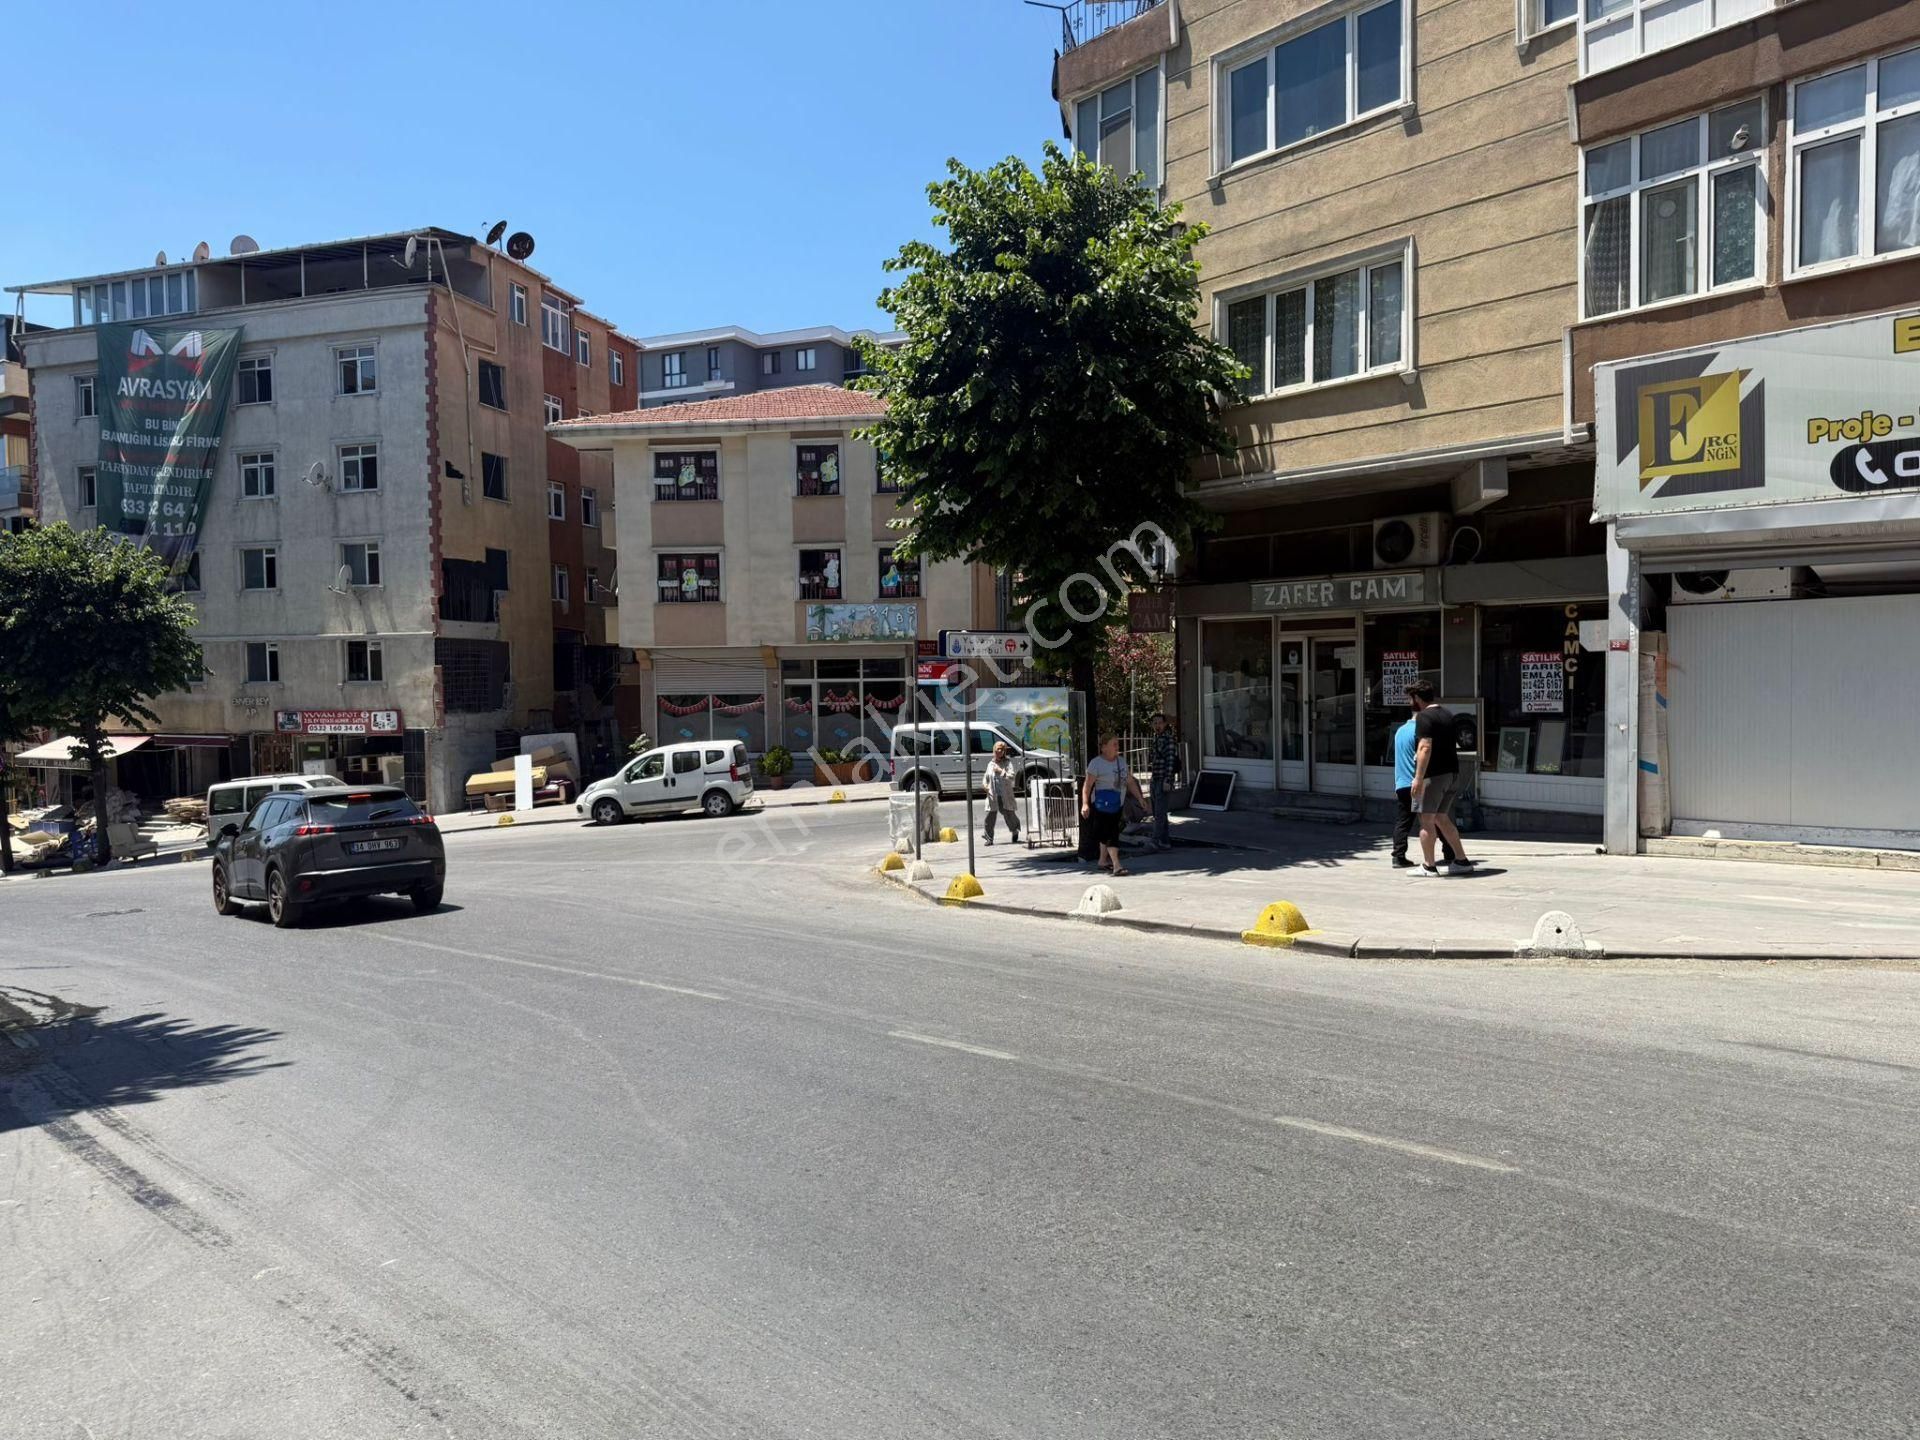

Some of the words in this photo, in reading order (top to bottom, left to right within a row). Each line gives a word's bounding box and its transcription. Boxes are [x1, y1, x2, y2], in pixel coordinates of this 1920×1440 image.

[145, 418, 159, 430] BU
[1808, 411, 1893, 444] Proje
[1264, 582, 1334, 606] ZAFER
[1350, 576, 1406, 600] CAM
[1383, 651, 1417, 660] SATILIK
[1522, 653, 1561, 662] SATILIK
[1522, 671, 1562, 680] EMLAK
[1533, 679, 1545, 689] 425
[1546, 679, 1562, 689] 6167
[1533, 690, 1545, 700] 347
[1546, 690, 1562, 700] 4022
